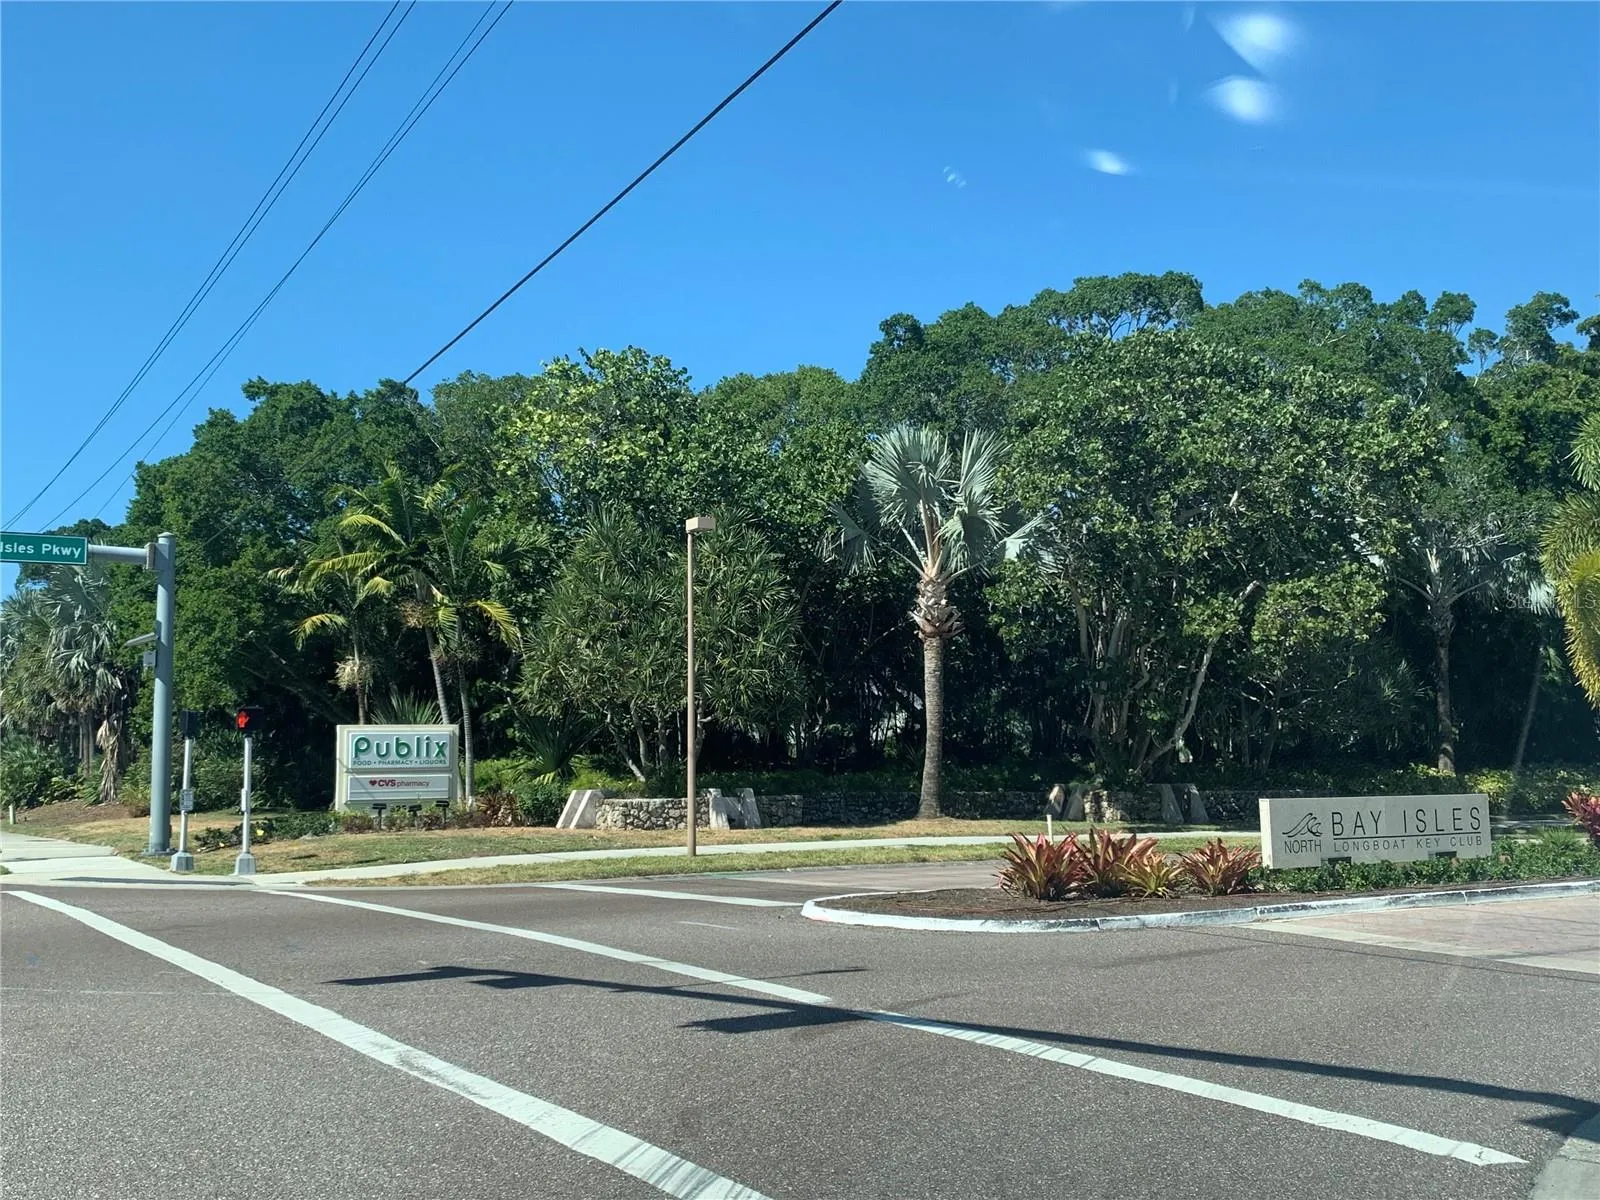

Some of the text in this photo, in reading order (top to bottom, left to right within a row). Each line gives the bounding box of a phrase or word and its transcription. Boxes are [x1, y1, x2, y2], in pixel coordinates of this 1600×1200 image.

[0, 542, 81, 559] Isles Pkwy
[353, 735, 447, 759] Publix
[378, 779, 430, 788] CVS pharmacy
[1331, 806, 1482, 837] BAY ISLES
[1284, 839, 1322, 854] NORTH
[1333, 835, 1483, 853] LONGBOAT KEY CLUB
